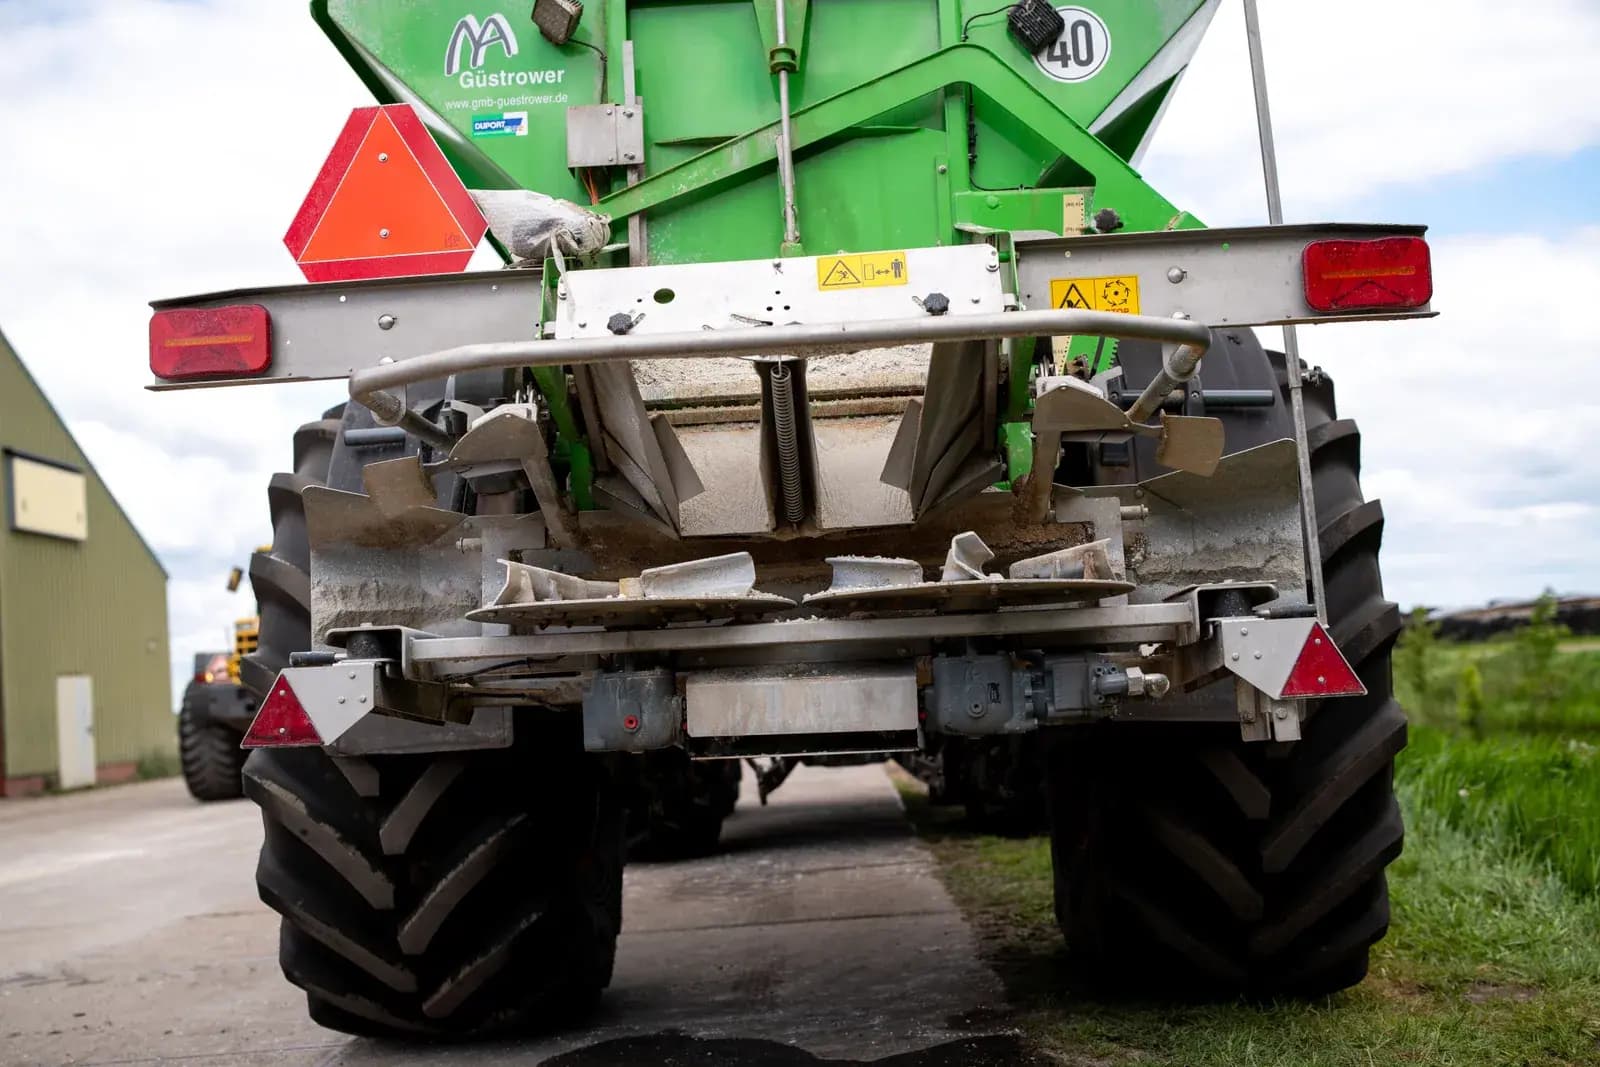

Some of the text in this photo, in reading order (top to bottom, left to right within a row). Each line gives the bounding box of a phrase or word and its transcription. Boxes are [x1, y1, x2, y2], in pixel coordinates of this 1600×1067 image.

[1047, 19, 1094, 68] 40
[459, 70, 565, 88] Güstrower
[445, 93, 568, 110] www.gmb-guestrower.de
